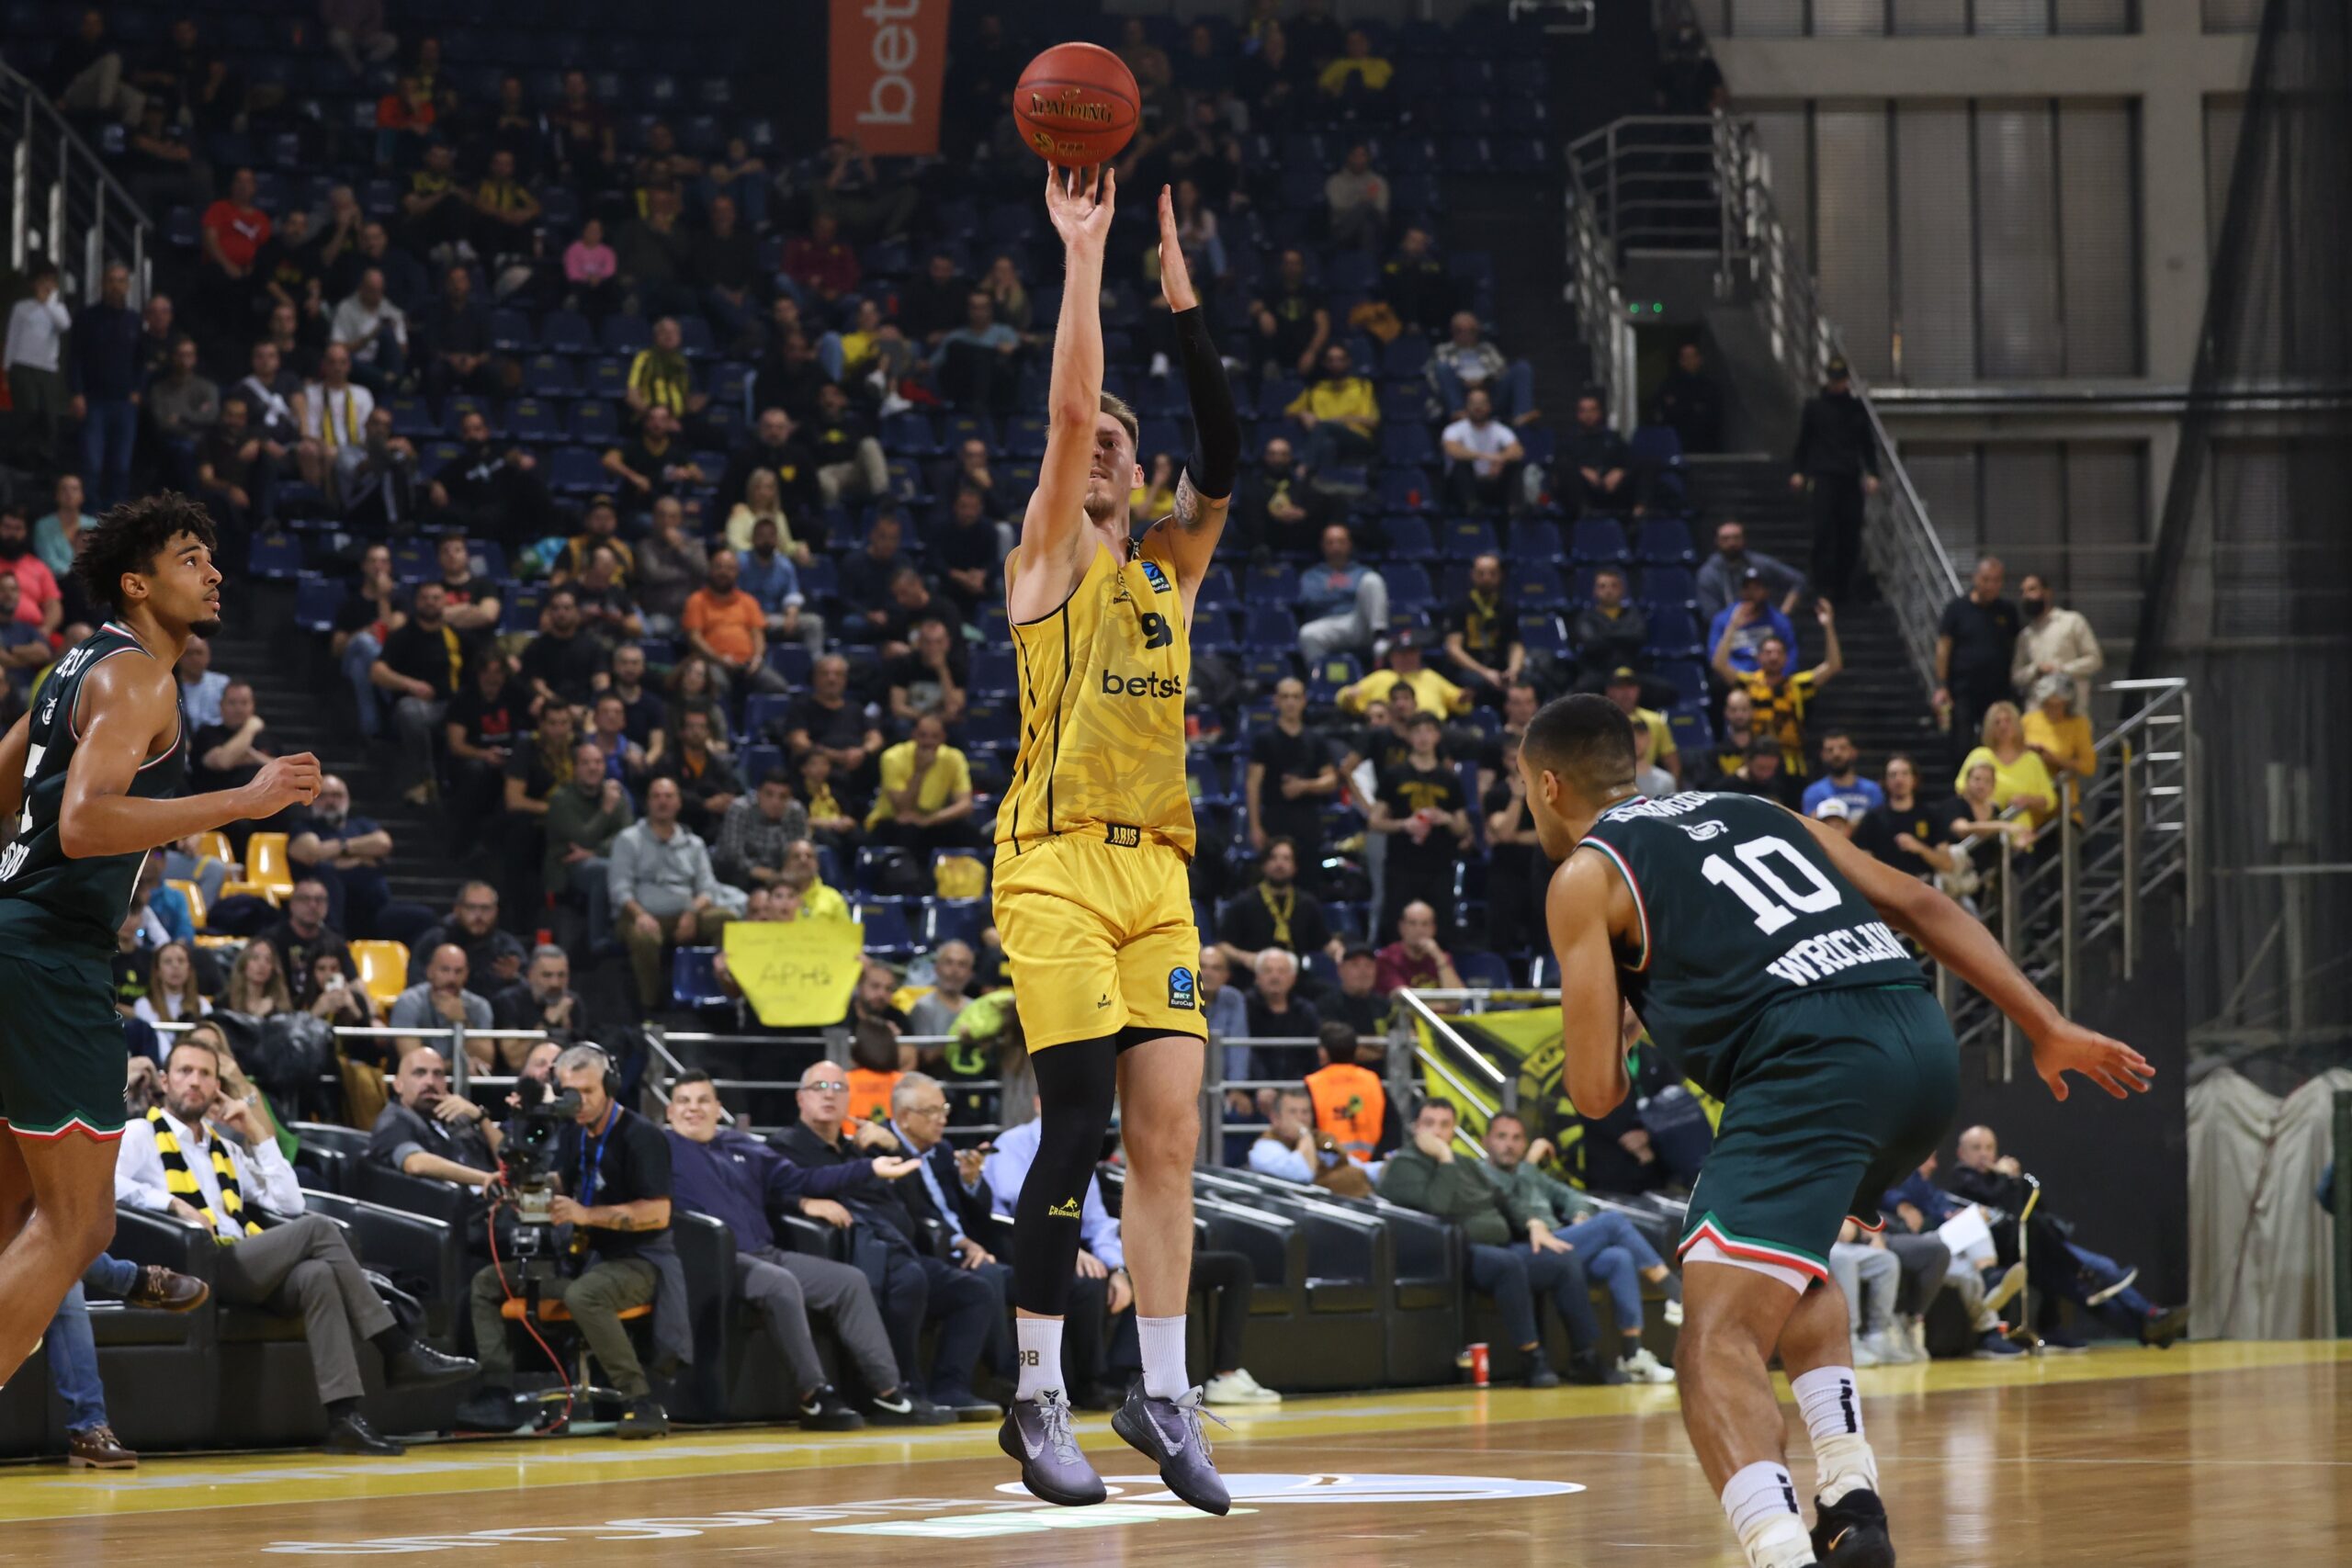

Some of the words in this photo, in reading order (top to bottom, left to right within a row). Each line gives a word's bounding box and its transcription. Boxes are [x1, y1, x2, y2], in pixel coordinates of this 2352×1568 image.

[1030, 93, 1113, 123] SPALDING
[1110, 827, 1137, 845] ARIS
[1702, 835, 1842, 936] 10
[1170, 998, 1193, 1008] EuroCup
